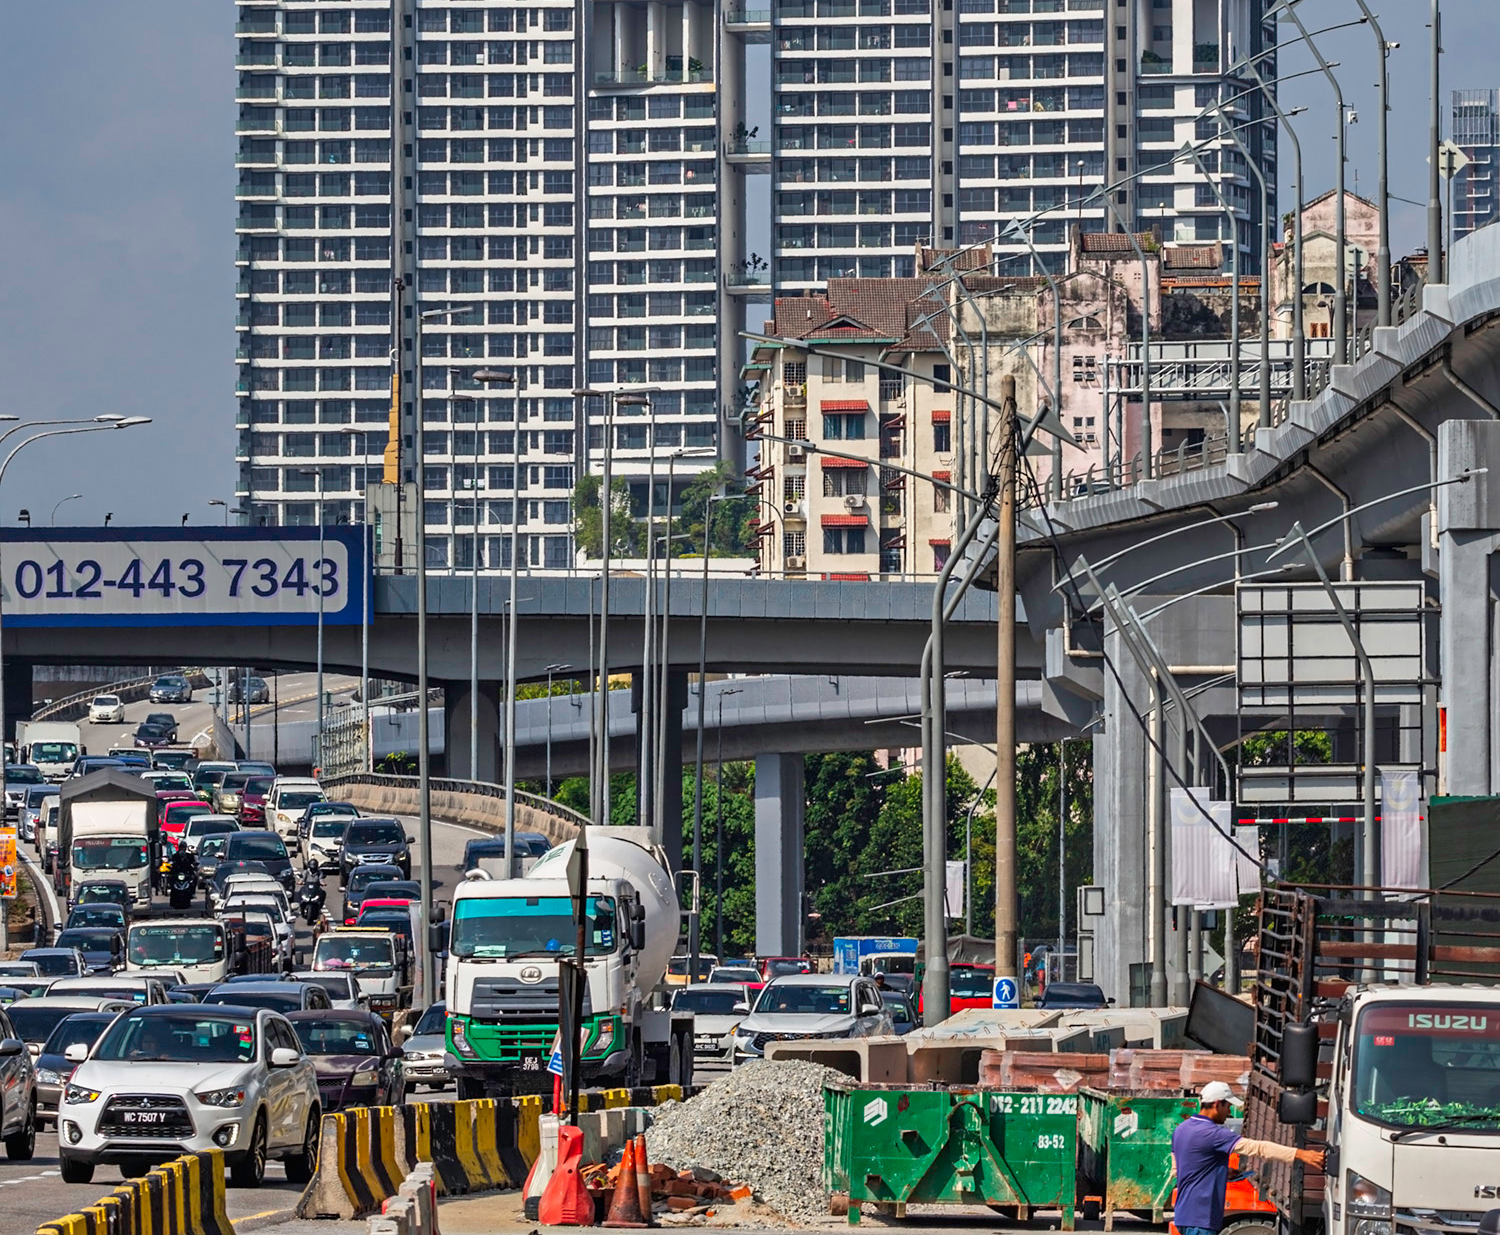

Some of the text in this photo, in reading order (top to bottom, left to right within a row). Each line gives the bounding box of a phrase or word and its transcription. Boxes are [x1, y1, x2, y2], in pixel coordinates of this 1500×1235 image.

[15, 558, 339, 599] 012-443 7343
[1408, 1013, 1487, 1030] ISUZU
[1046, 1097, 1078, 1114] 2242
[124, 1112, 166, 1122] WC 7507 Y
